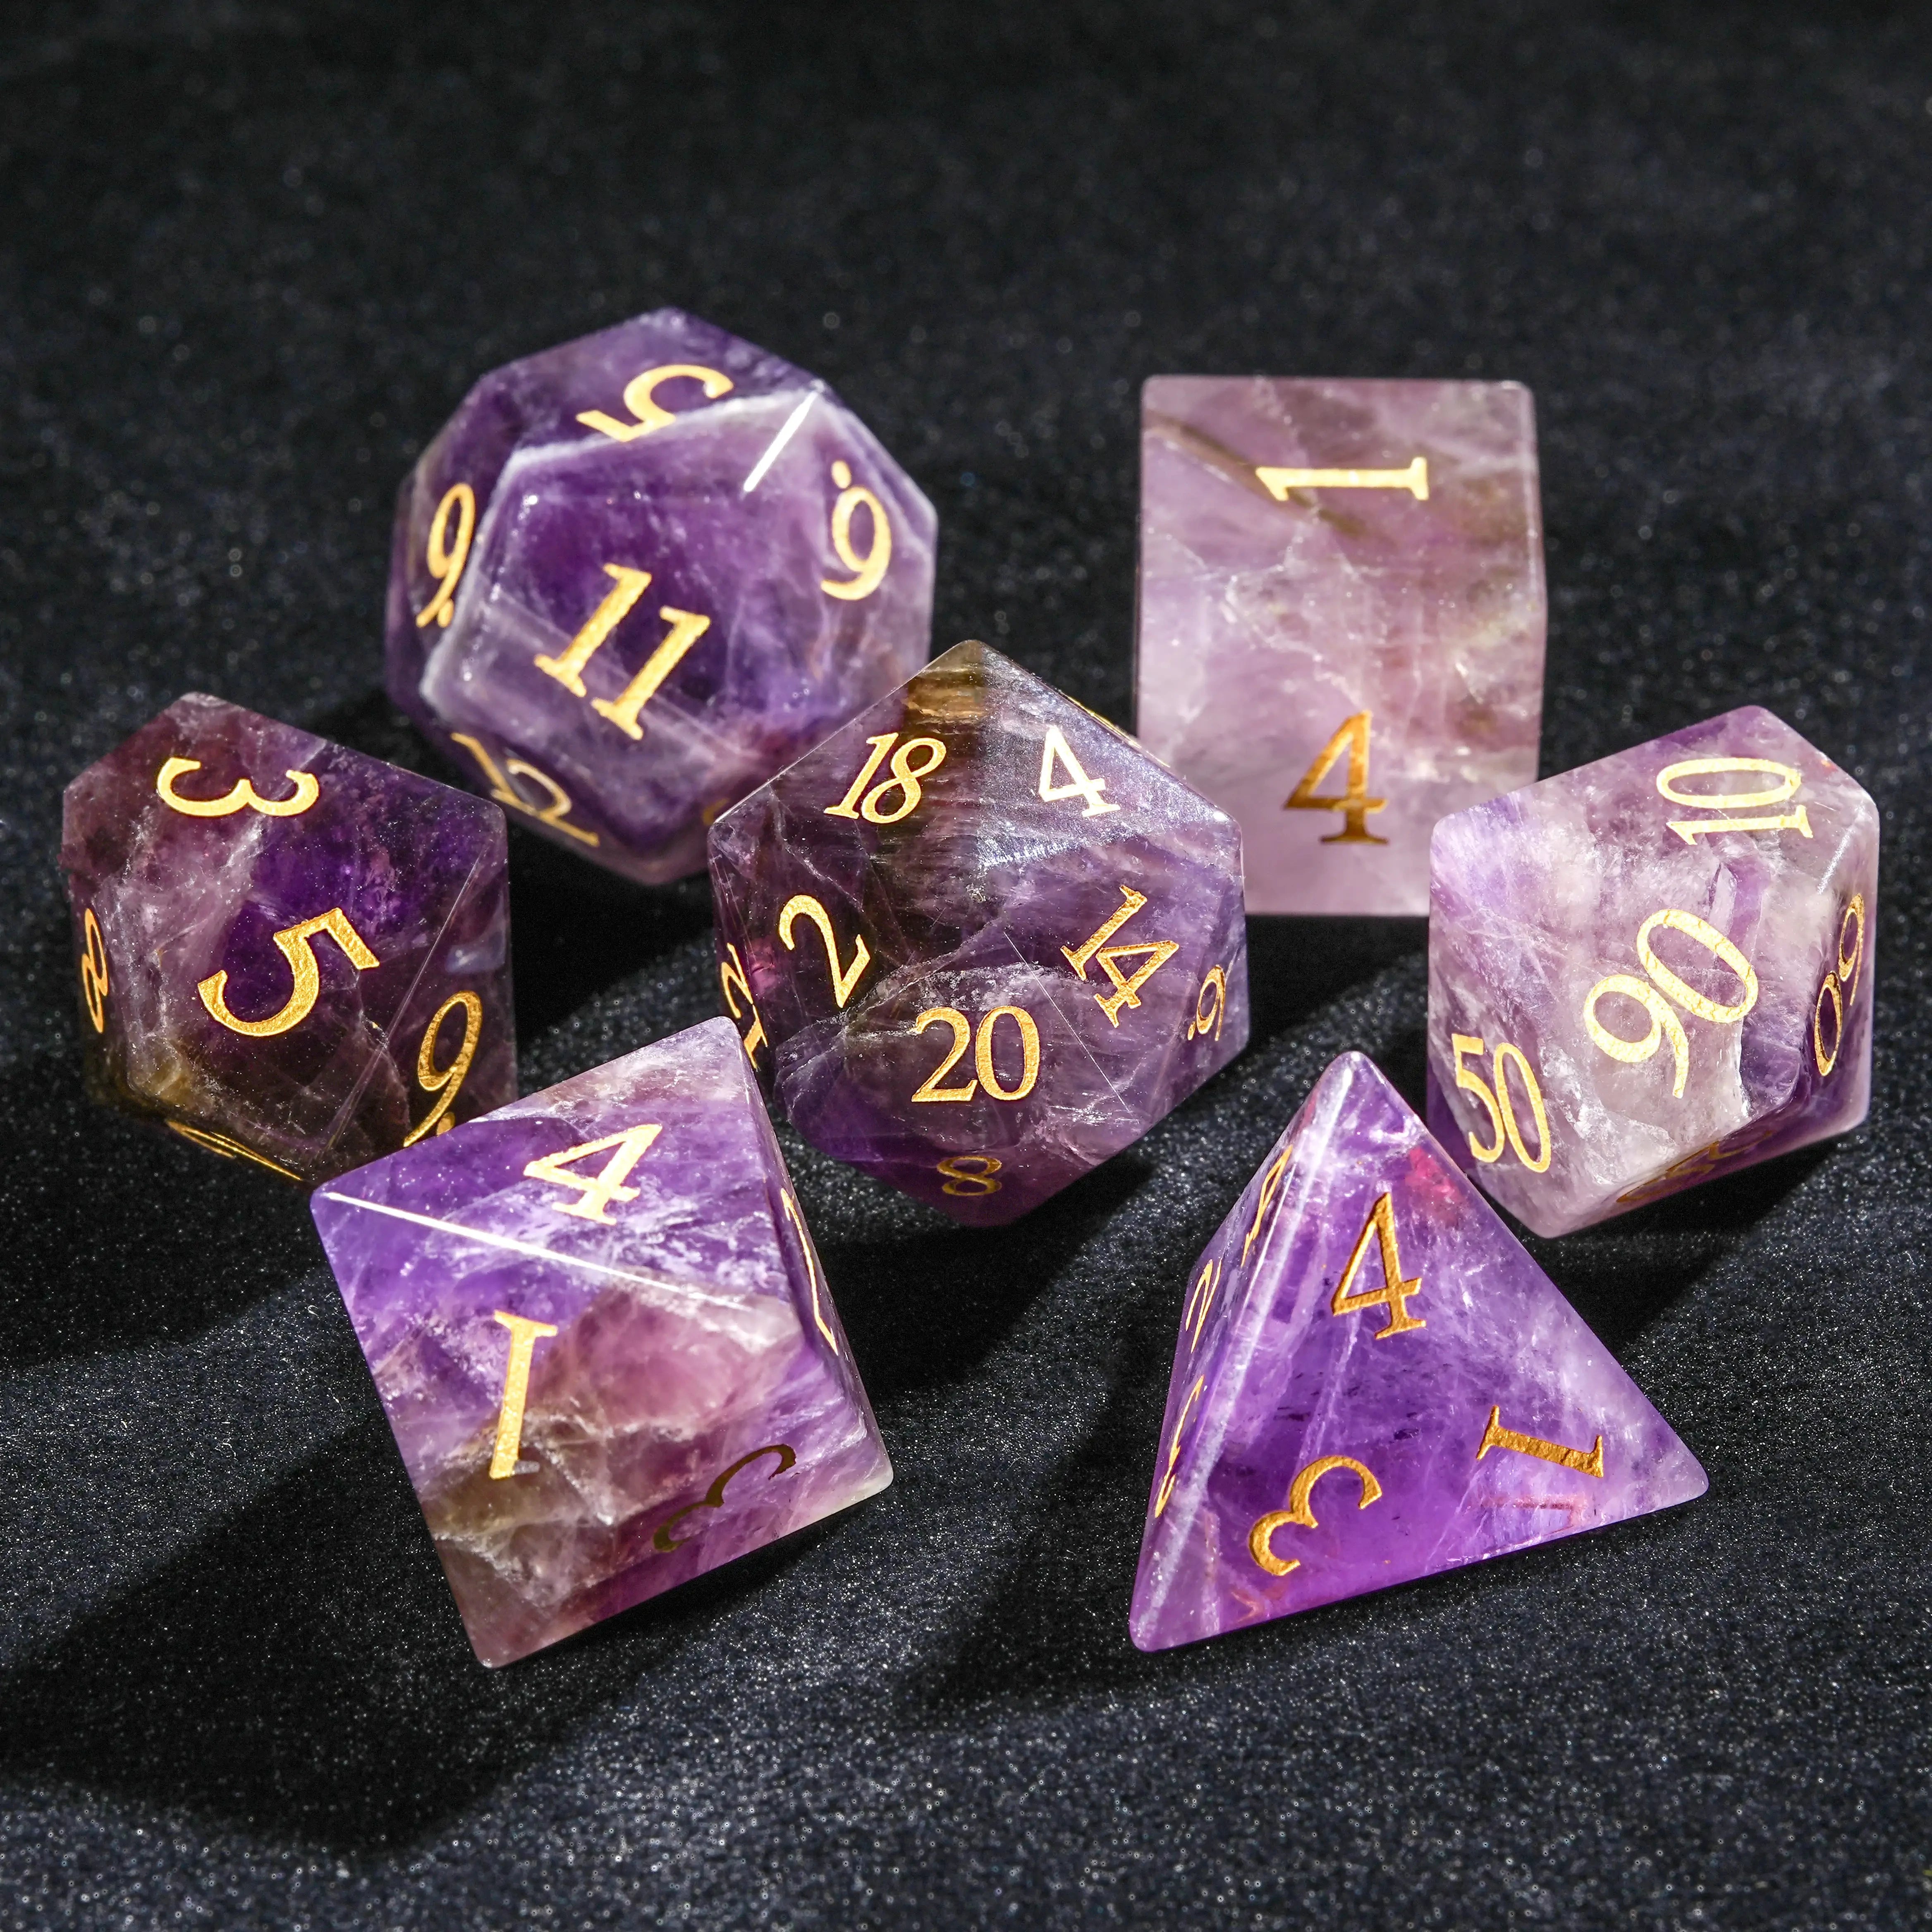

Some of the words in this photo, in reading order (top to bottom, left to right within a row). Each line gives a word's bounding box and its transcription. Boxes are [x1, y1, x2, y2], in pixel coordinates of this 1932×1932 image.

[575, 362, 734, 442] 5
[1255, 457, 1429, 500] 1
[533, 562, 711, 740] 11
[156, 757, 320, 817] 3
[823, 732, 947, 824] 18
[1038, 724, 1121, 817] 4
[1283, 710, 1390, 846] 4
[1656, 757, 1814, 845] 10
[197, 907, 380, 1037] 5
[777, 894, 871, 1009] 2
[1060, 884, 1179, 1027] 14
[1583, 909, 1759, 1098] 90
[911, 1006, 1040, 1102] 20
[1451, 1033, 1552, 1173] 50
[523, 1123, 663, 1226] 4
[936, 1156, 1002, 1196] 8
[1331, 1192, 1427, 1340] 4
[489, 1309, 558, 1480] 1
[1476, 1405, 1604, 1479] 1
[653, 1443, 796, 1553] 3
[1248, 1455, 1383, 1576] 3
